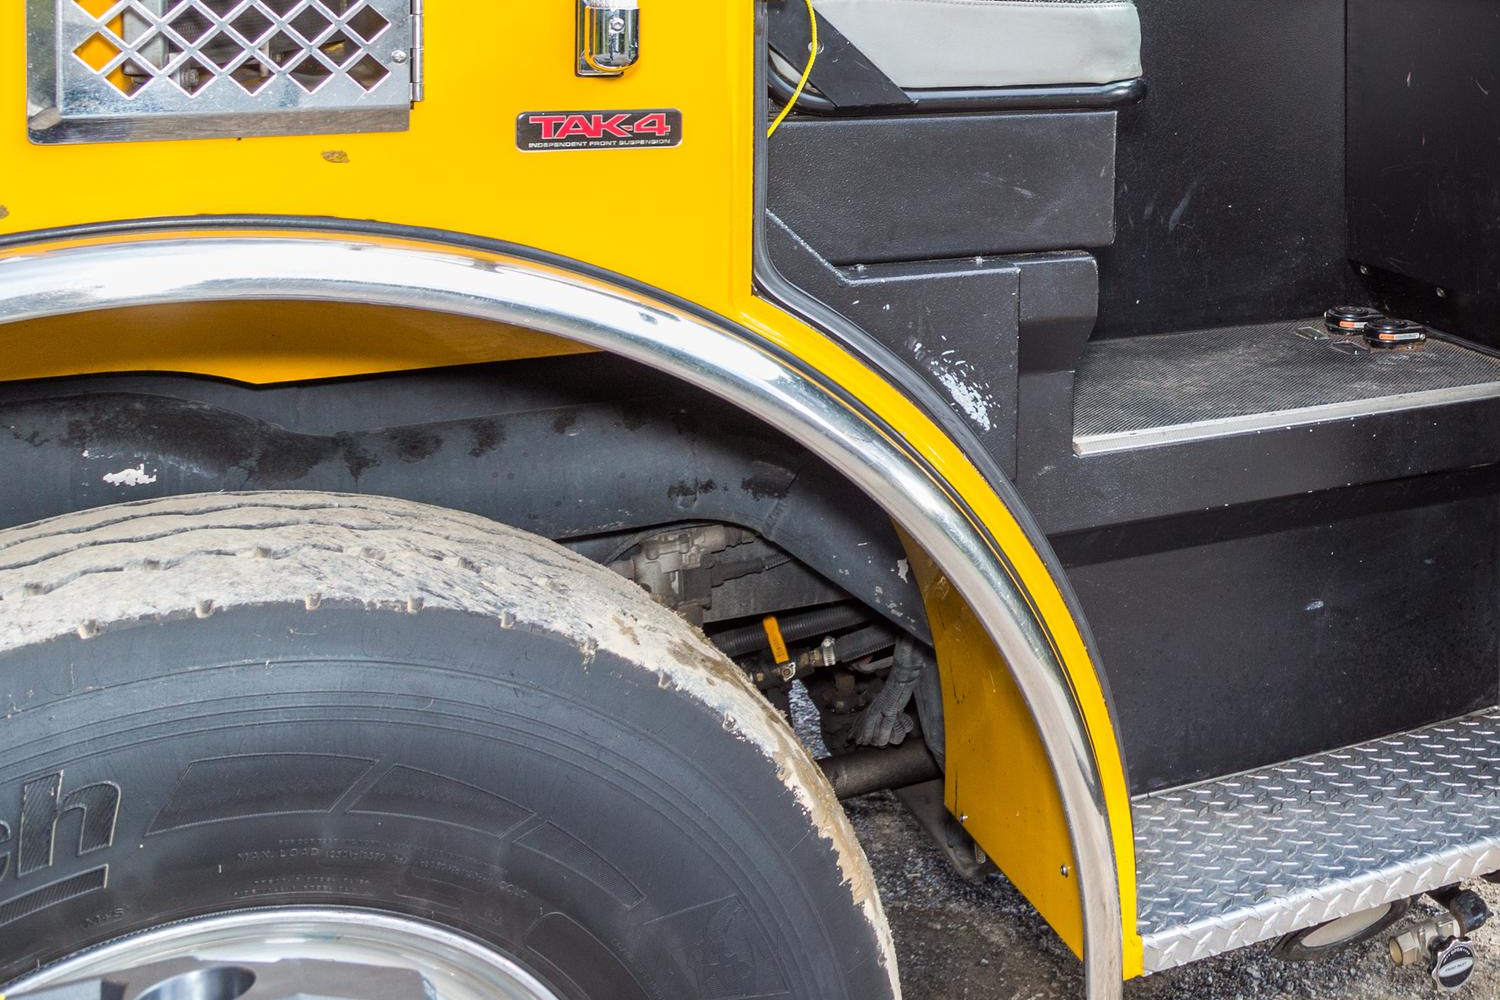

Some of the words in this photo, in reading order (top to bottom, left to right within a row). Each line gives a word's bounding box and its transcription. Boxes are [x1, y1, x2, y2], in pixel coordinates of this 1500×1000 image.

[528, 113, 671, 140] TAK-4
[528, 140, 587, 149] INDEPENDENT
[588, 139, 616, 147] FRONT
[618, 138, 671, 146] SUSPENSION
[0, 769, 121, 883] h
